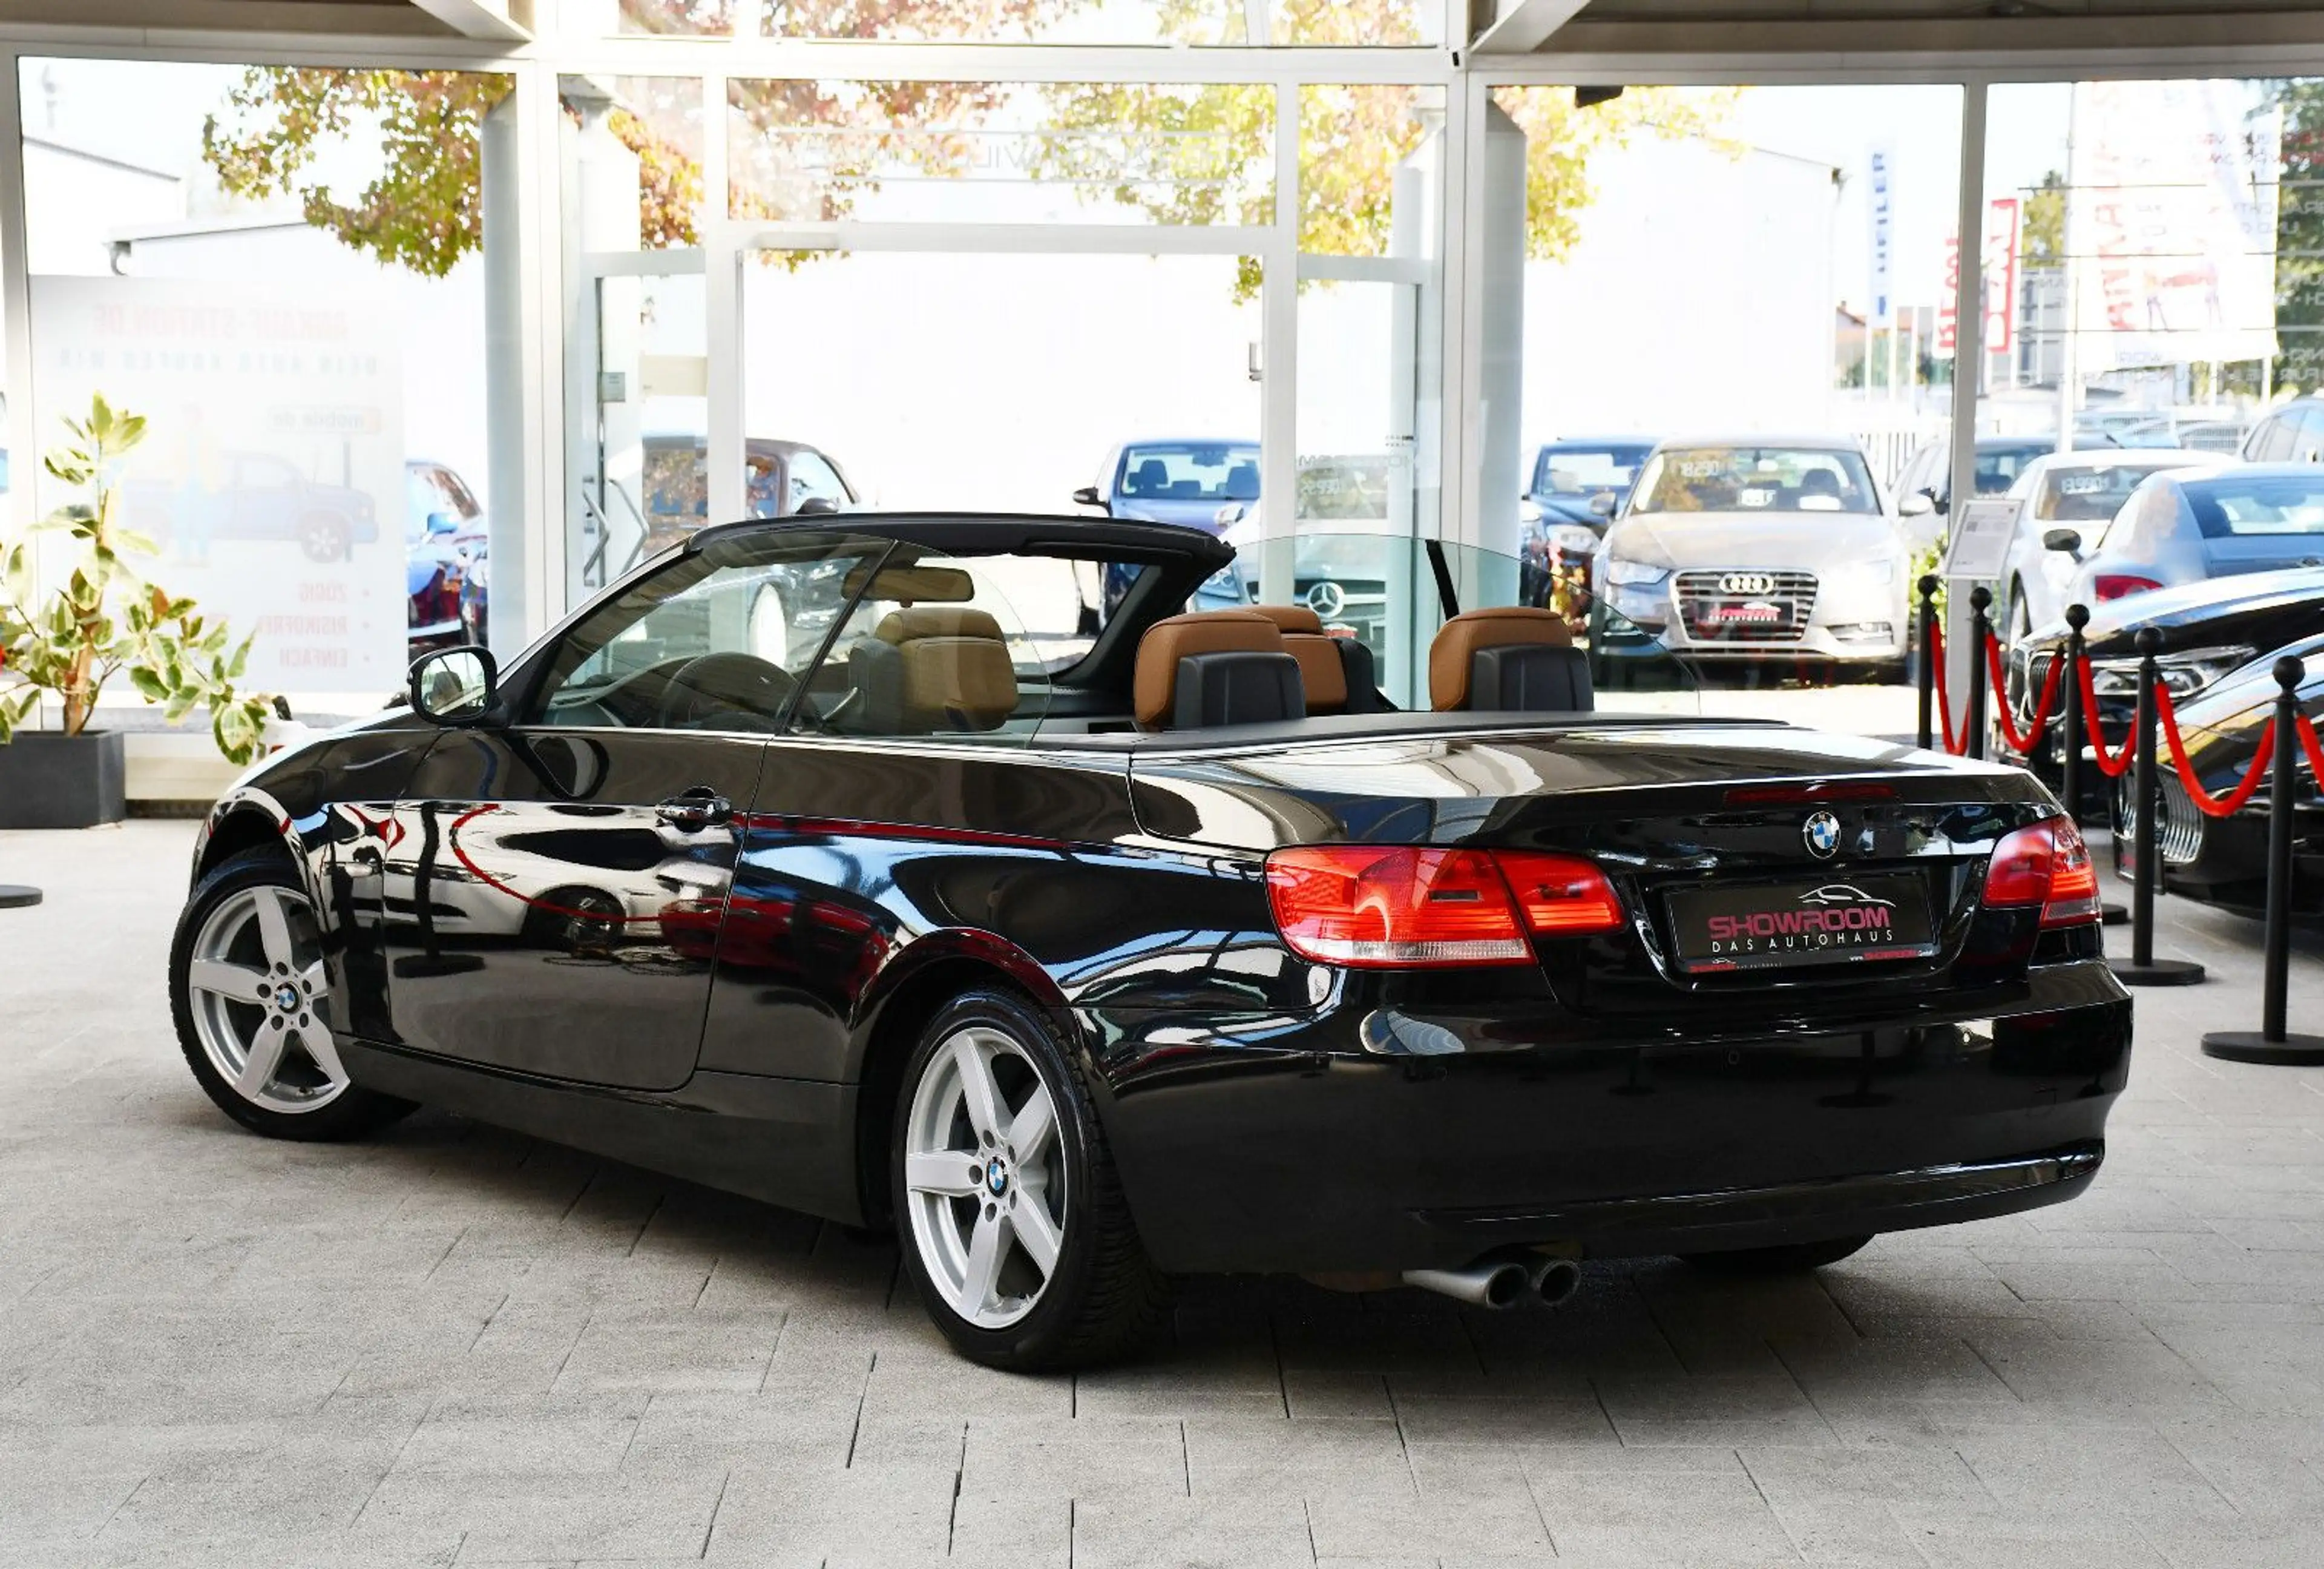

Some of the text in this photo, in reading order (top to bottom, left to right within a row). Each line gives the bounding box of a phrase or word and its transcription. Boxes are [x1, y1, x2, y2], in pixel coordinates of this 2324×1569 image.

[1709, 907, 1891, 939] SHOWROOM
[1712, 930, 1892, 953] DAS AUTOHAUS
